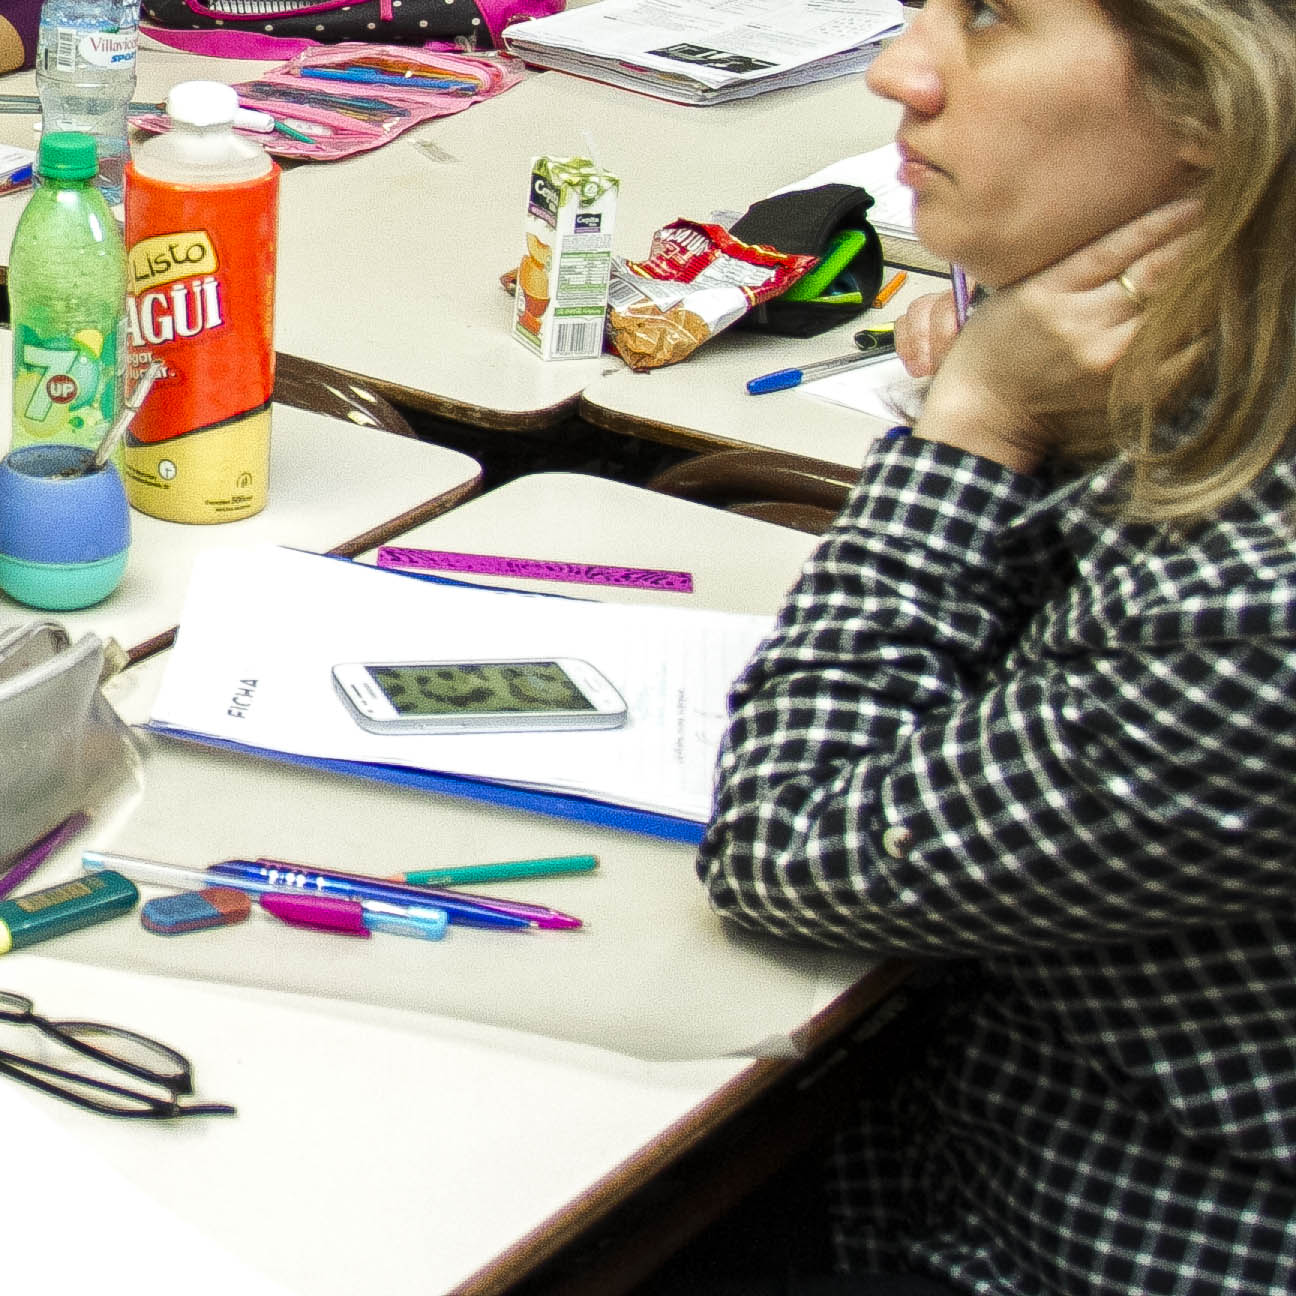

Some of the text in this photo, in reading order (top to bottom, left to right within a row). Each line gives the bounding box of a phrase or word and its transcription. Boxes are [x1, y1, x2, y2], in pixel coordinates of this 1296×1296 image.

[23, 344, 79, 422] 7 UP
[227, 679, 259, 720] FICHA
